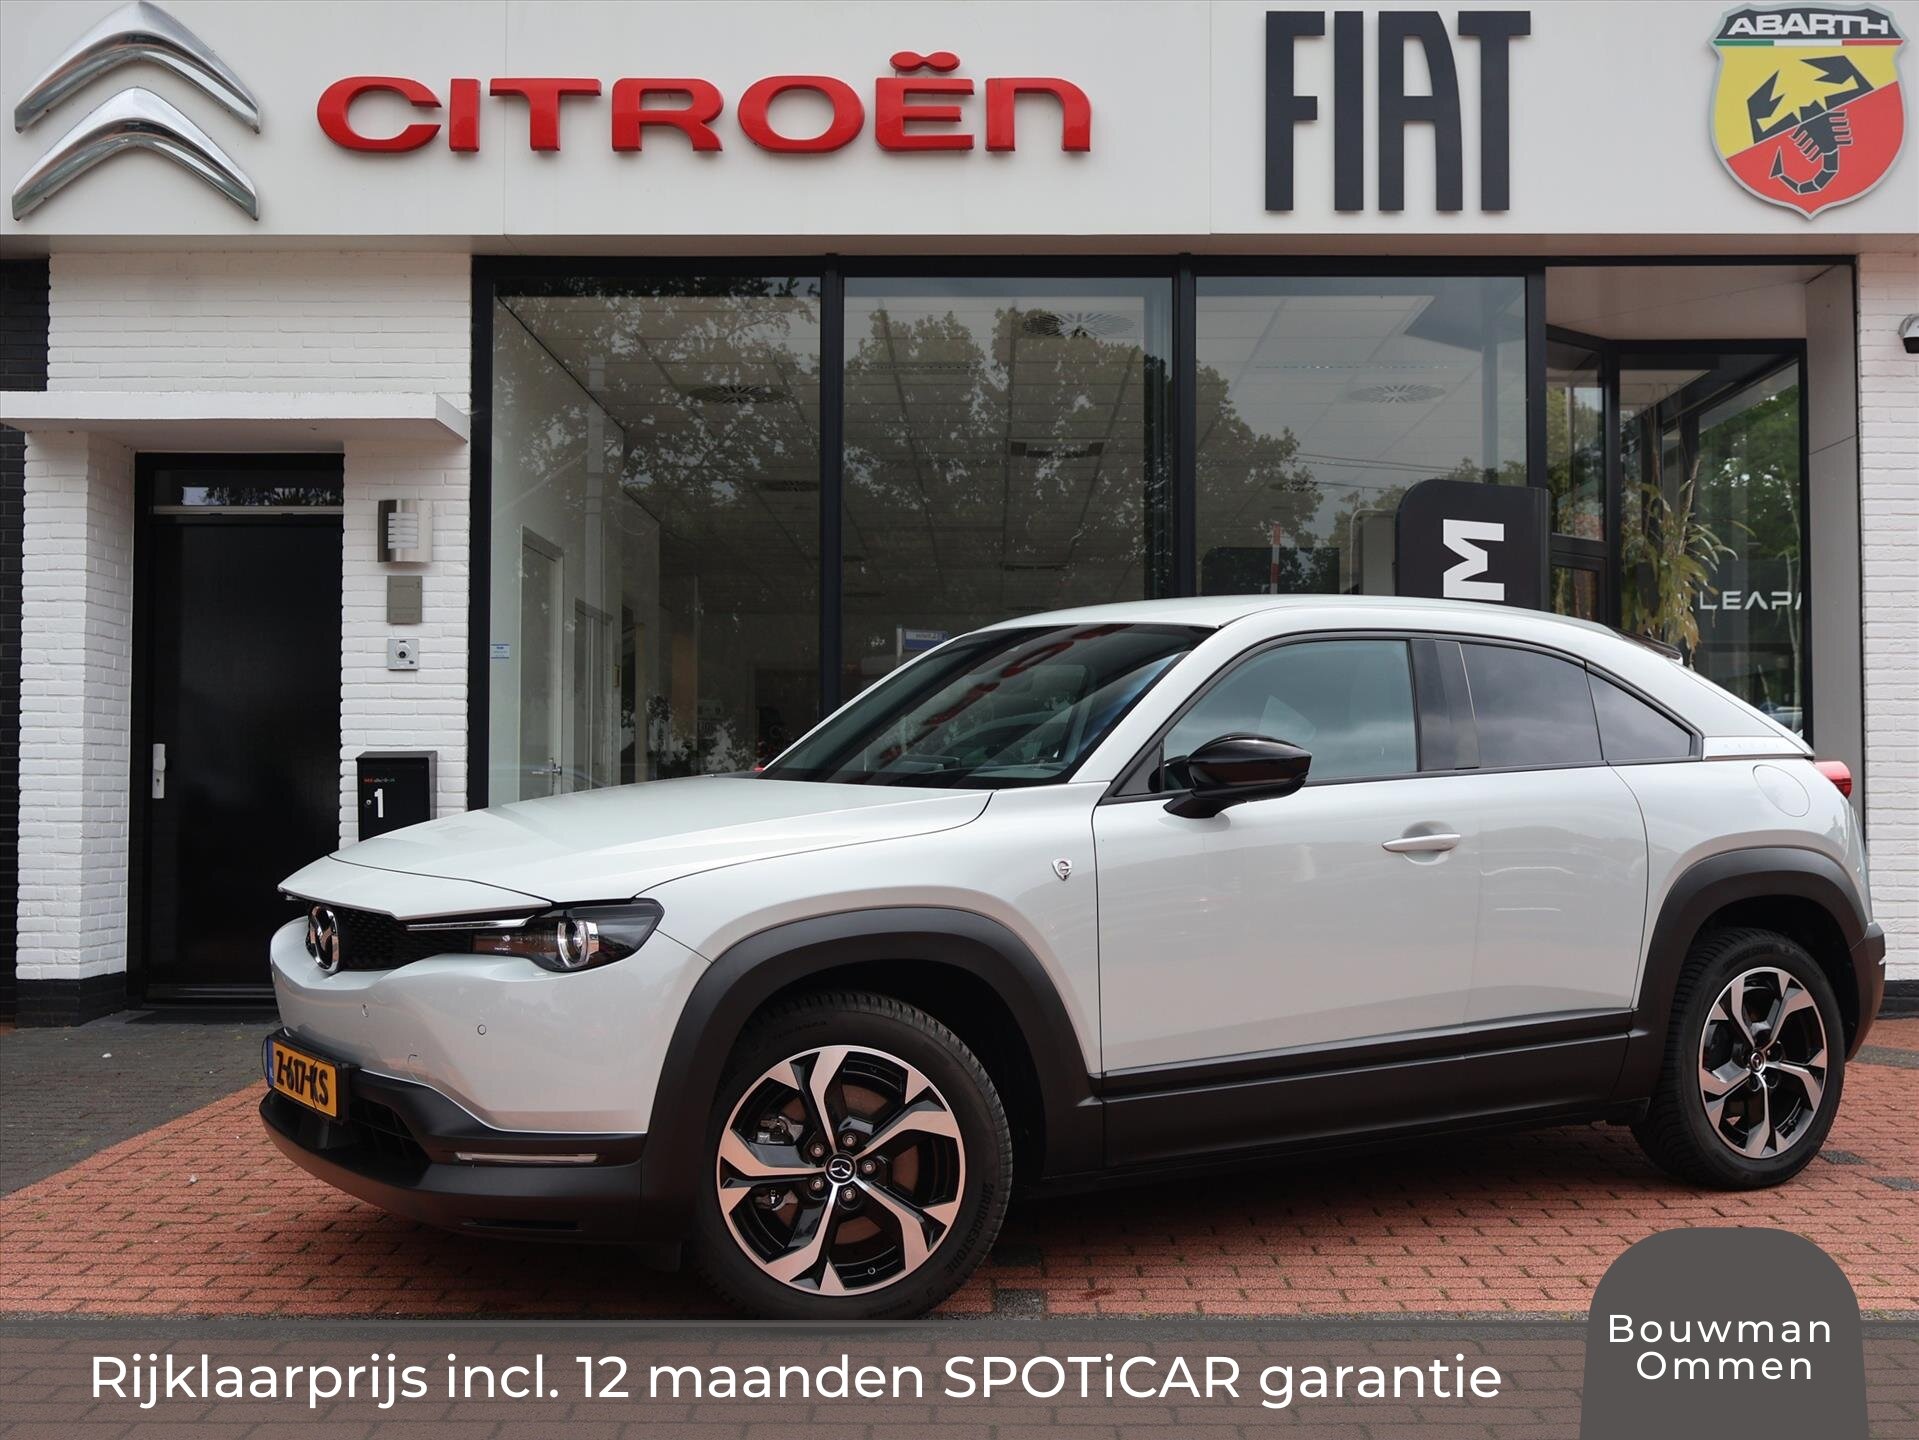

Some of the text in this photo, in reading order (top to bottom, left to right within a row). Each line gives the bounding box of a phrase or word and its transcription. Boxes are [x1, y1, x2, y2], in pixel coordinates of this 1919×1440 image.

[1727, 13, 1889, 35] ABARTH
[317, 51, 1091, 153] CITROËN
[1265, 11, 1531, 211] FIAT
[374, 788, 384, 818] 1
[942, 1181, 995, 1277] BRIDGESTONE
